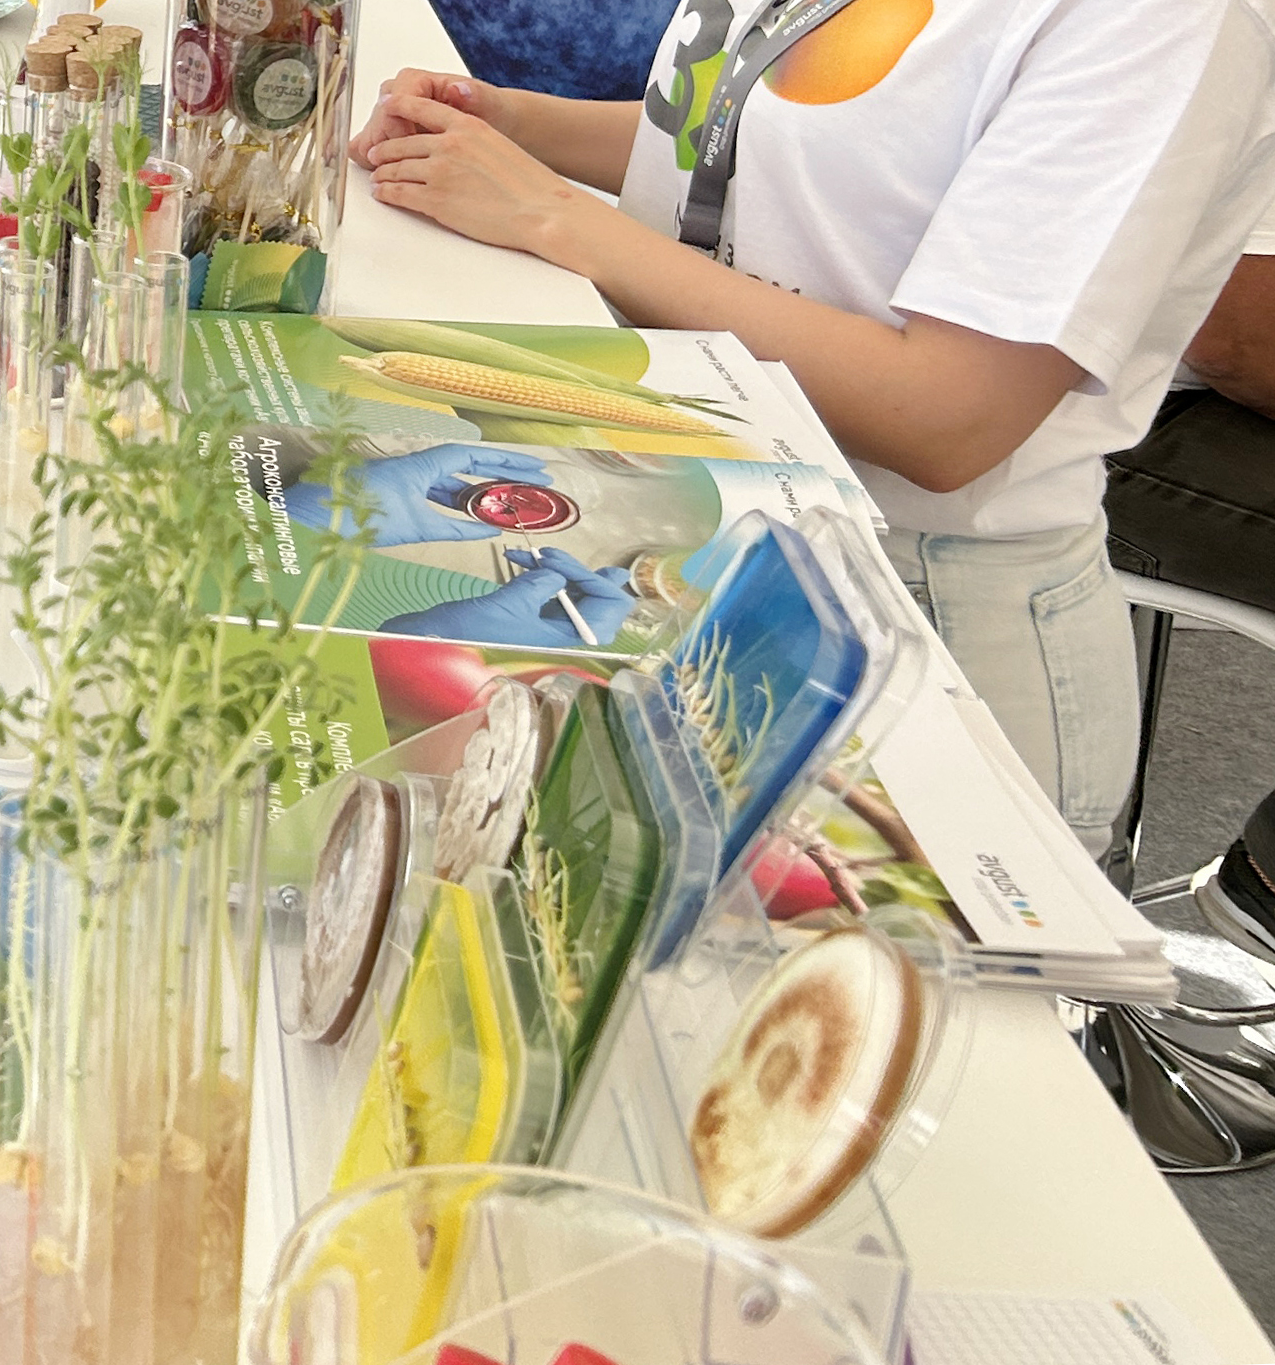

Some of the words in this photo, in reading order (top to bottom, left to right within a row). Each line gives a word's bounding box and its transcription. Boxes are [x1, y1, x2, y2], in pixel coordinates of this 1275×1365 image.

[782, 1, 824, 36] avgust
[261, 83, 305, 98] avgust
[703, 124, 723, 167] avgust
[772, 438, 802, 461] avgust
[774, 472, 791, 480] С
[254, 436, 302, 575] Агроконсалтинговые
[977, 854, 1029, 897] avgust
